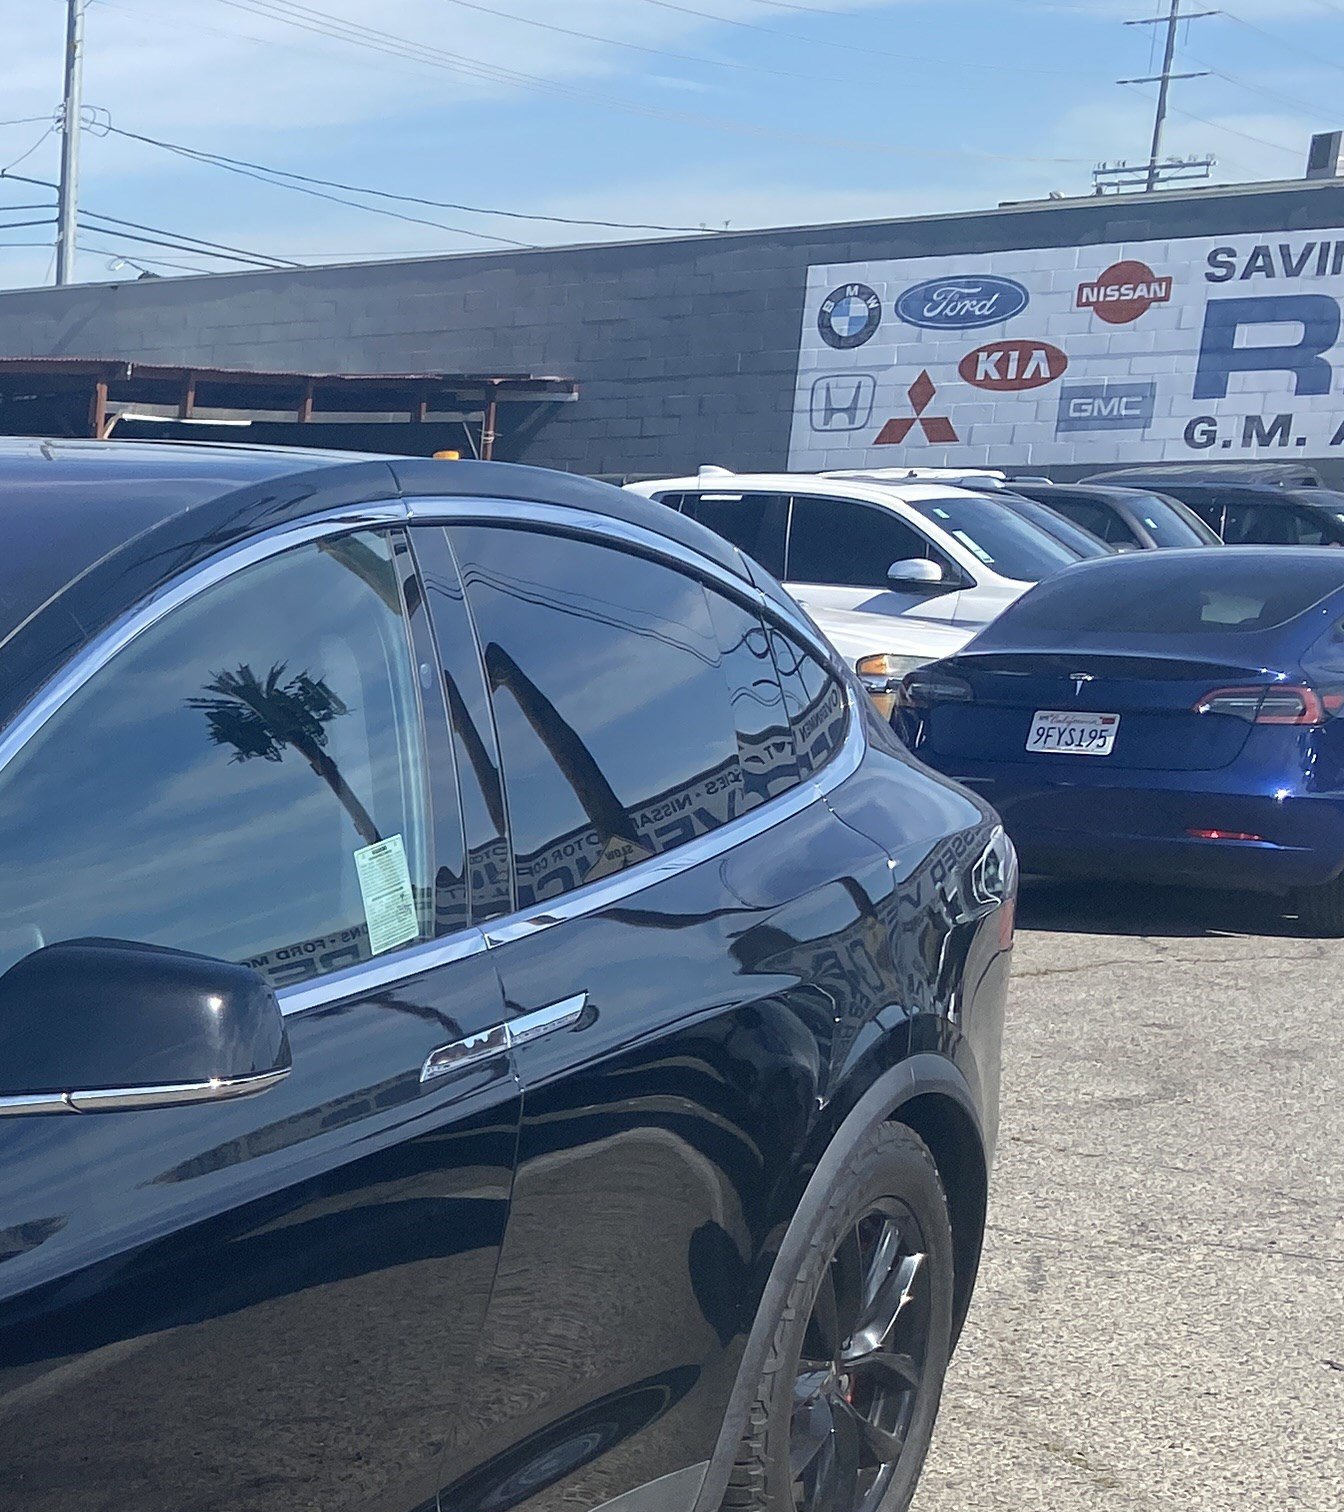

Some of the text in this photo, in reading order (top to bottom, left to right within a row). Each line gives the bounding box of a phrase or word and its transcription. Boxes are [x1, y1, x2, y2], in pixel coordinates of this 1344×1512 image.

[822, 284, 880, 314] BMW
[922, 286, 1000, 319] Ford
[1080, 281, 1167, 304] NISSAN
[974, 348, 1052, 382] KIA
[1068, 396, 1144, 418] GMC
[1183, 412, 1308, 450] G.M.
[1032, 726, 1110, 748] 9FYS195
